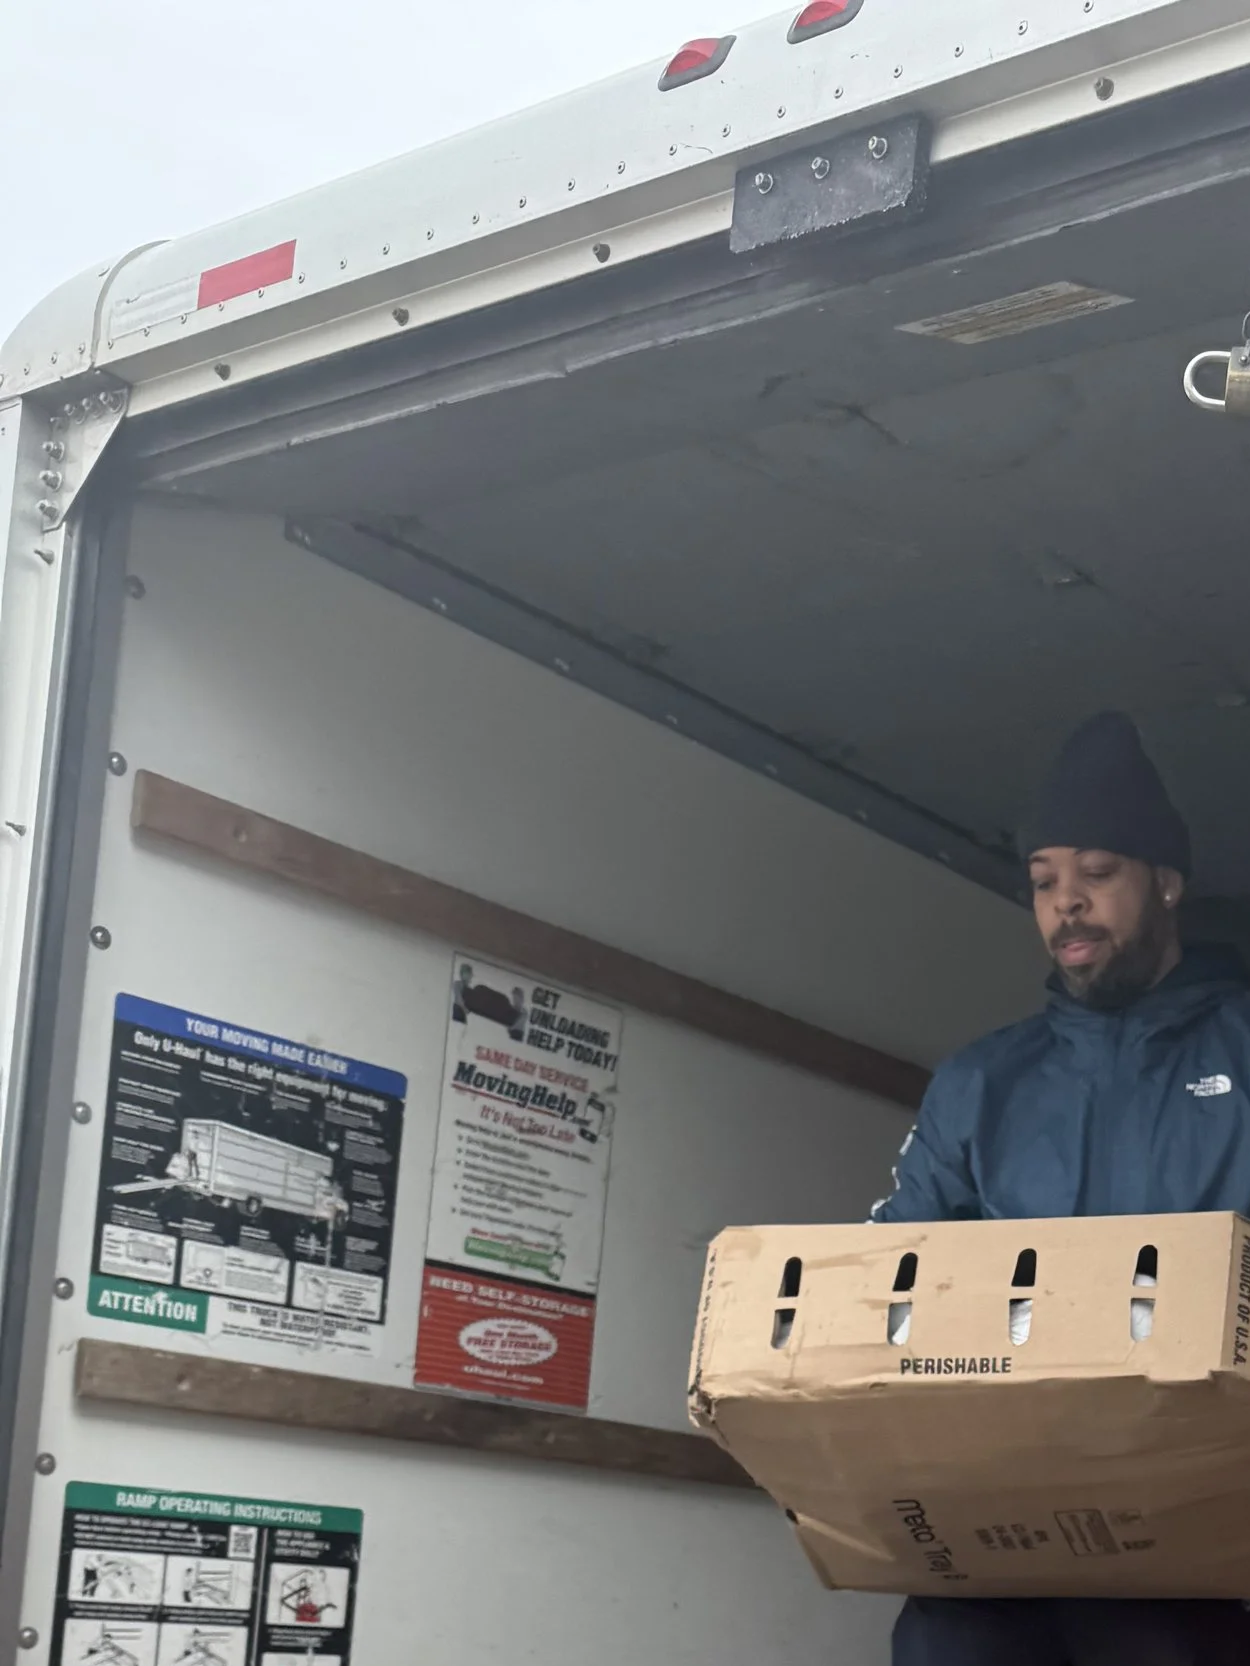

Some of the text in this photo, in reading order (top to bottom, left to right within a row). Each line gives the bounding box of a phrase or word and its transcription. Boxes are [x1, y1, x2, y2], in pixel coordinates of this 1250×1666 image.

[531, 986, 561, 1010] GET
[187, 1018, 218, 1039] YOUR
[221, 1027, 269, 1053] MOVING
[271, 1040, 304, 1062] MADE
[526, 1028, 565, 1053] HELP
[529, 1007, 611, 1048] UNLOADING
[134, 1031, 160, 1052] Only
[205, 1050, 225, 1067] has
[227, 1055, 246, 1072] the
[248, 1060, 273, 1080] right
[474, 1045, 589, 1092] SAME DAY SERVICE
[480, 1105, 500, 1123] It's
[430, 1275, 474, 1293] NEED
[95, 1289, 198, 1322] ATTENTION
[1236, 1303, 1250, 1324] OF
[1233, 1326, 1249, 1366] U.S.A.
[900, 1356, 1013, 1376] PERISHABLE
[116, 1492, 322, 1526] RAMP OPERATING INSTRUCTIONS
